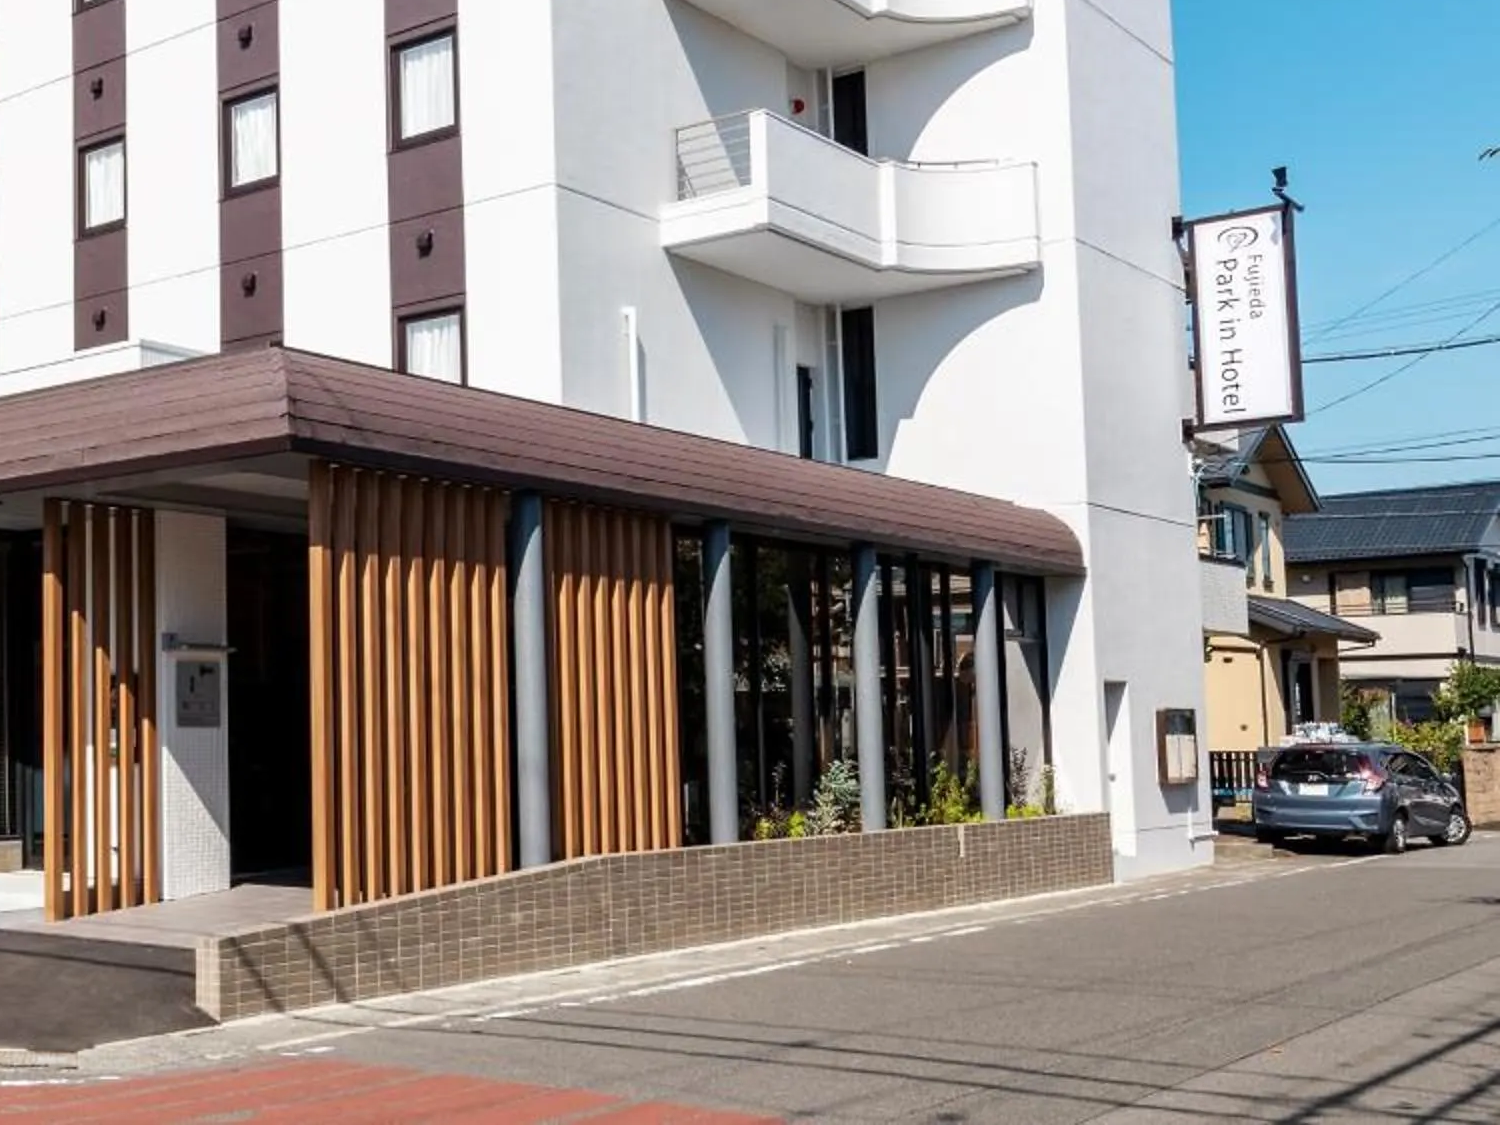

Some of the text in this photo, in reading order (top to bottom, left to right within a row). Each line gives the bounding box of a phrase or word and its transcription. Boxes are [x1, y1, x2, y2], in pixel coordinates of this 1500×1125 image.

[1216, 257, 1247, 414] Park in Hotel
[1243, 254, 1263, 320] Fujieda
